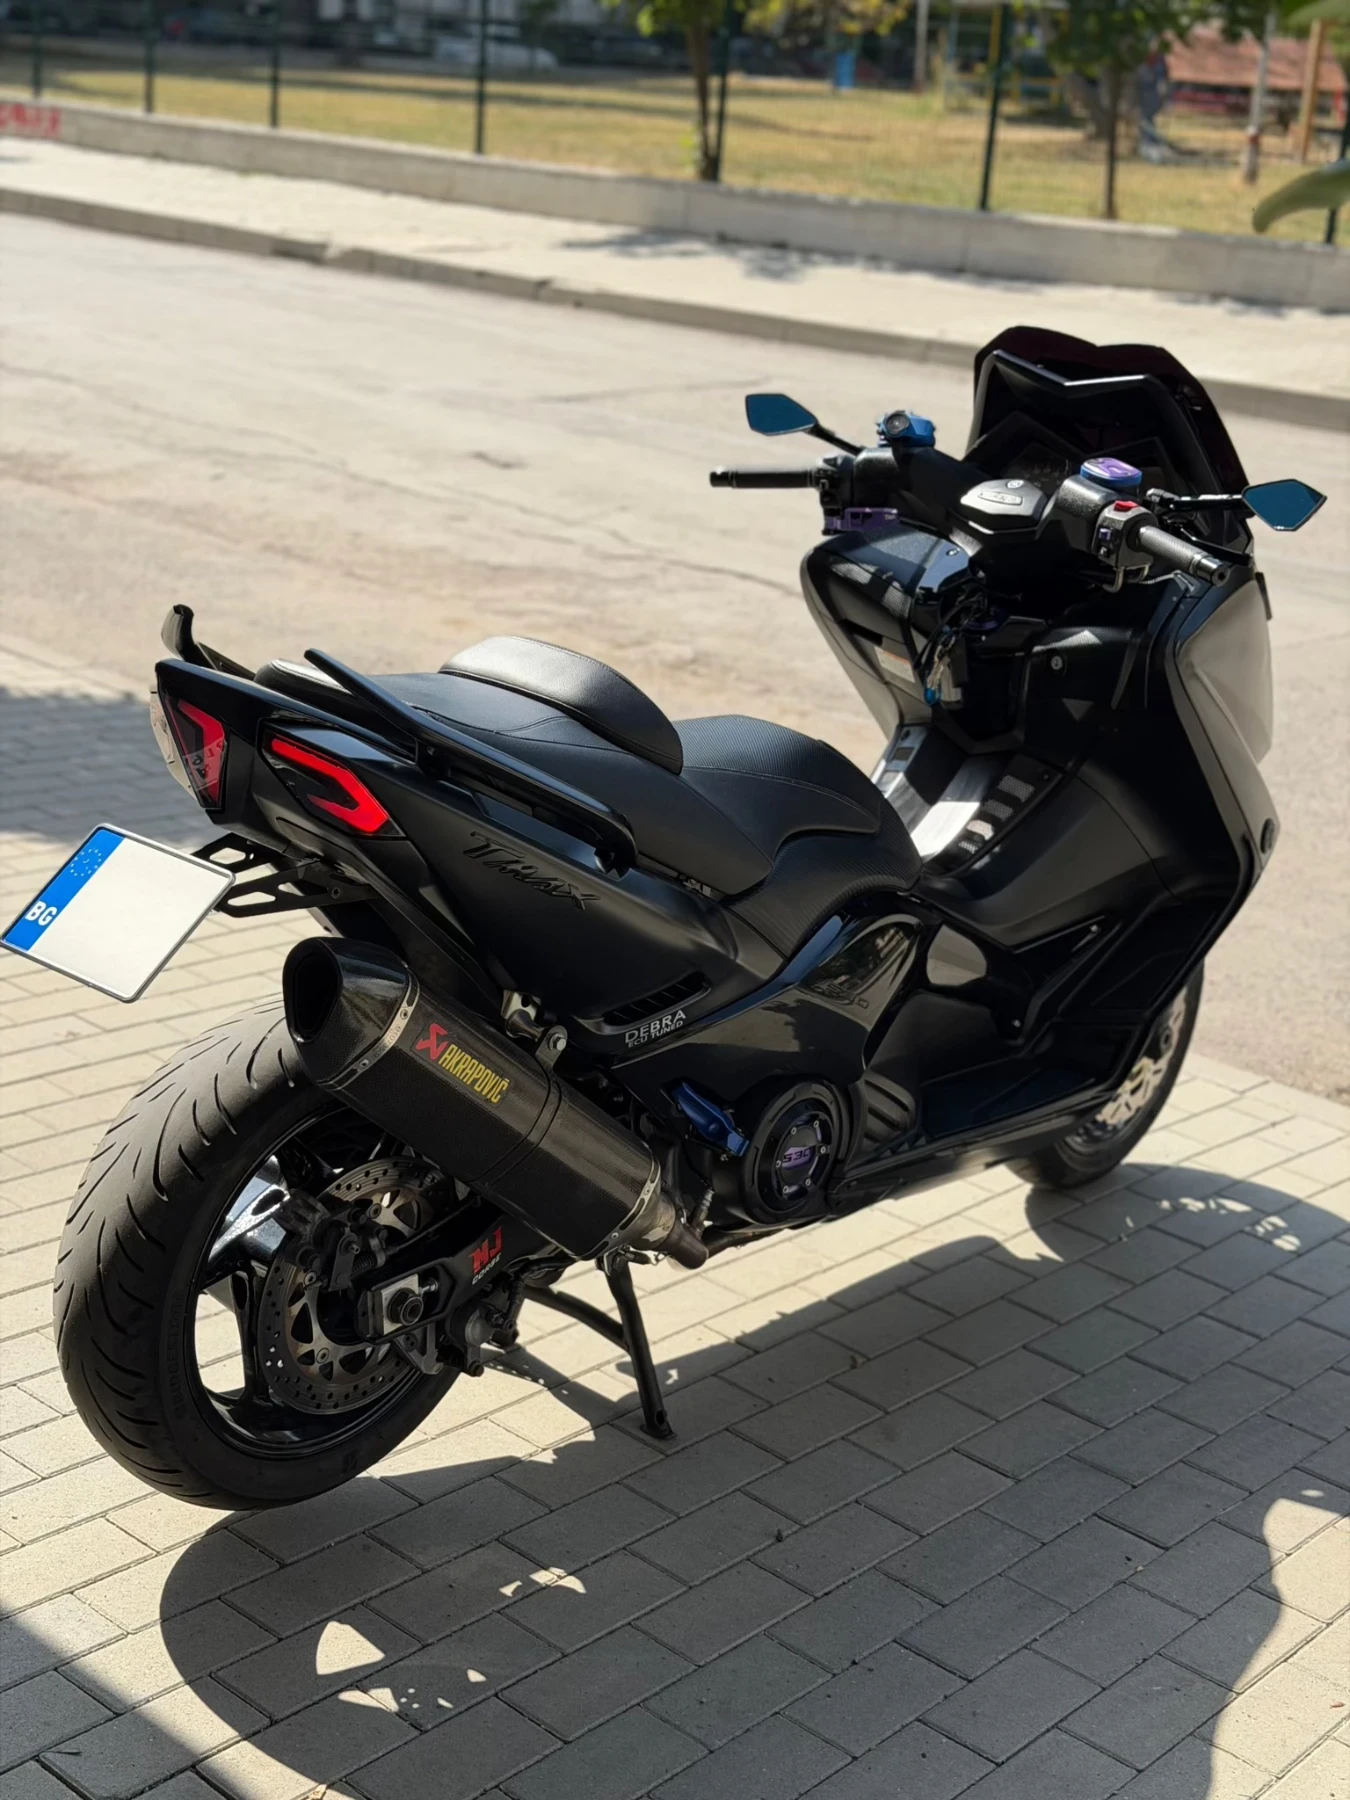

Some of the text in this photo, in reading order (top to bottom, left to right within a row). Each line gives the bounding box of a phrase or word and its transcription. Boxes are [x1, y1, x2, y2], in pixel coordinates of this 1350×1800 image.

[24, 900, 58, 926] BG
[625, 1009, 686, 1043] DEBRA
[628, 1020, 684, 1048] ECU TUNED
[468, 1226, 503, 1275] MJ
